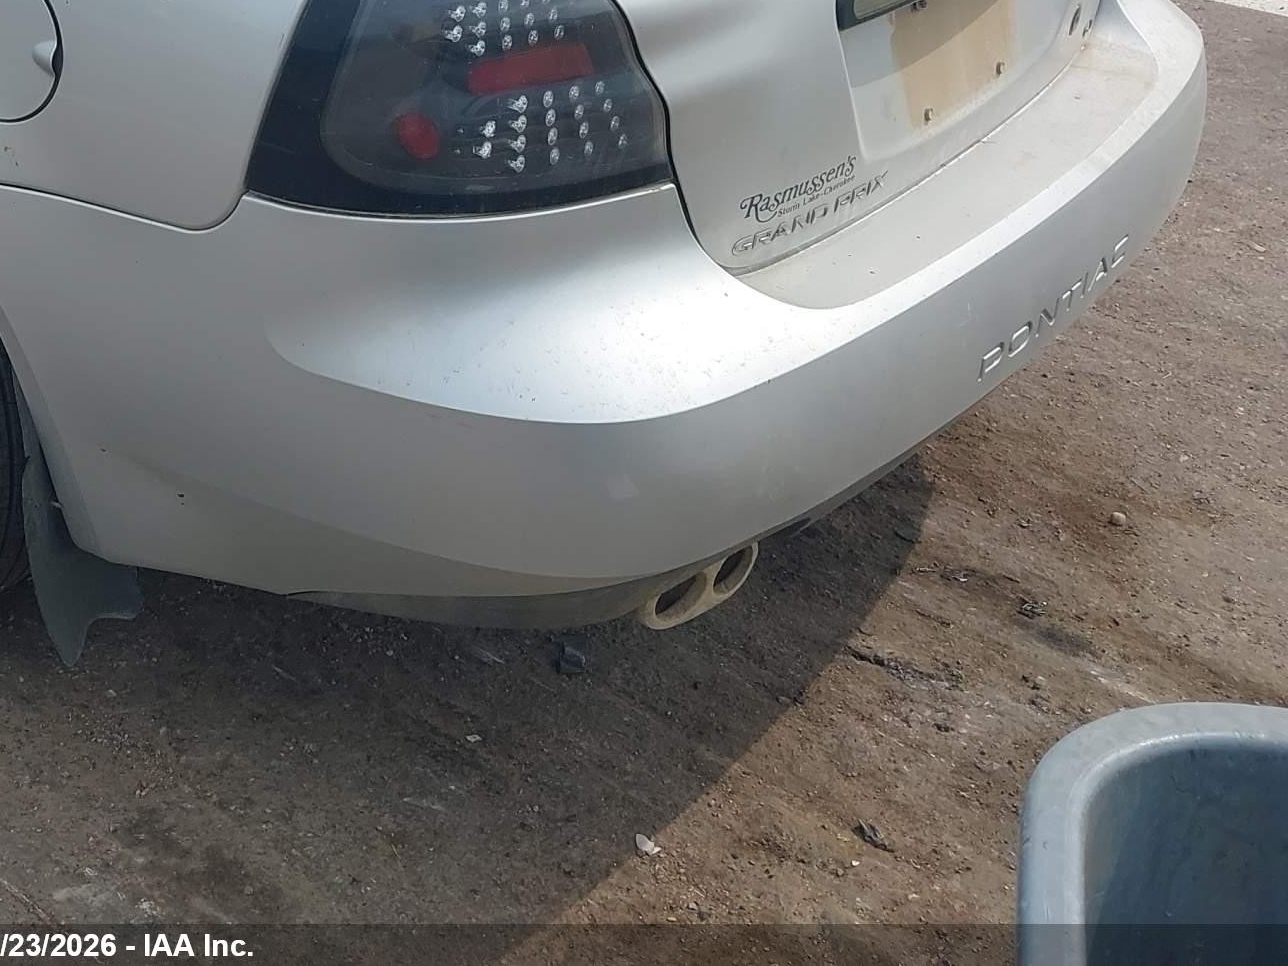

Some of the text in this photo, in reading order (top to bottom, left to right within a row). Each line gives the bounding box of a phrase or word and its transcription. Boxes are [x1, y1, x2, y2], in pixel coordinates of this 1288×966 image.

[731, 170, 889, 256] GRAND PRIX
[740, 155, 856, 223] Rasmussen's
[976, 233, 1129, 382] PONTIAC
